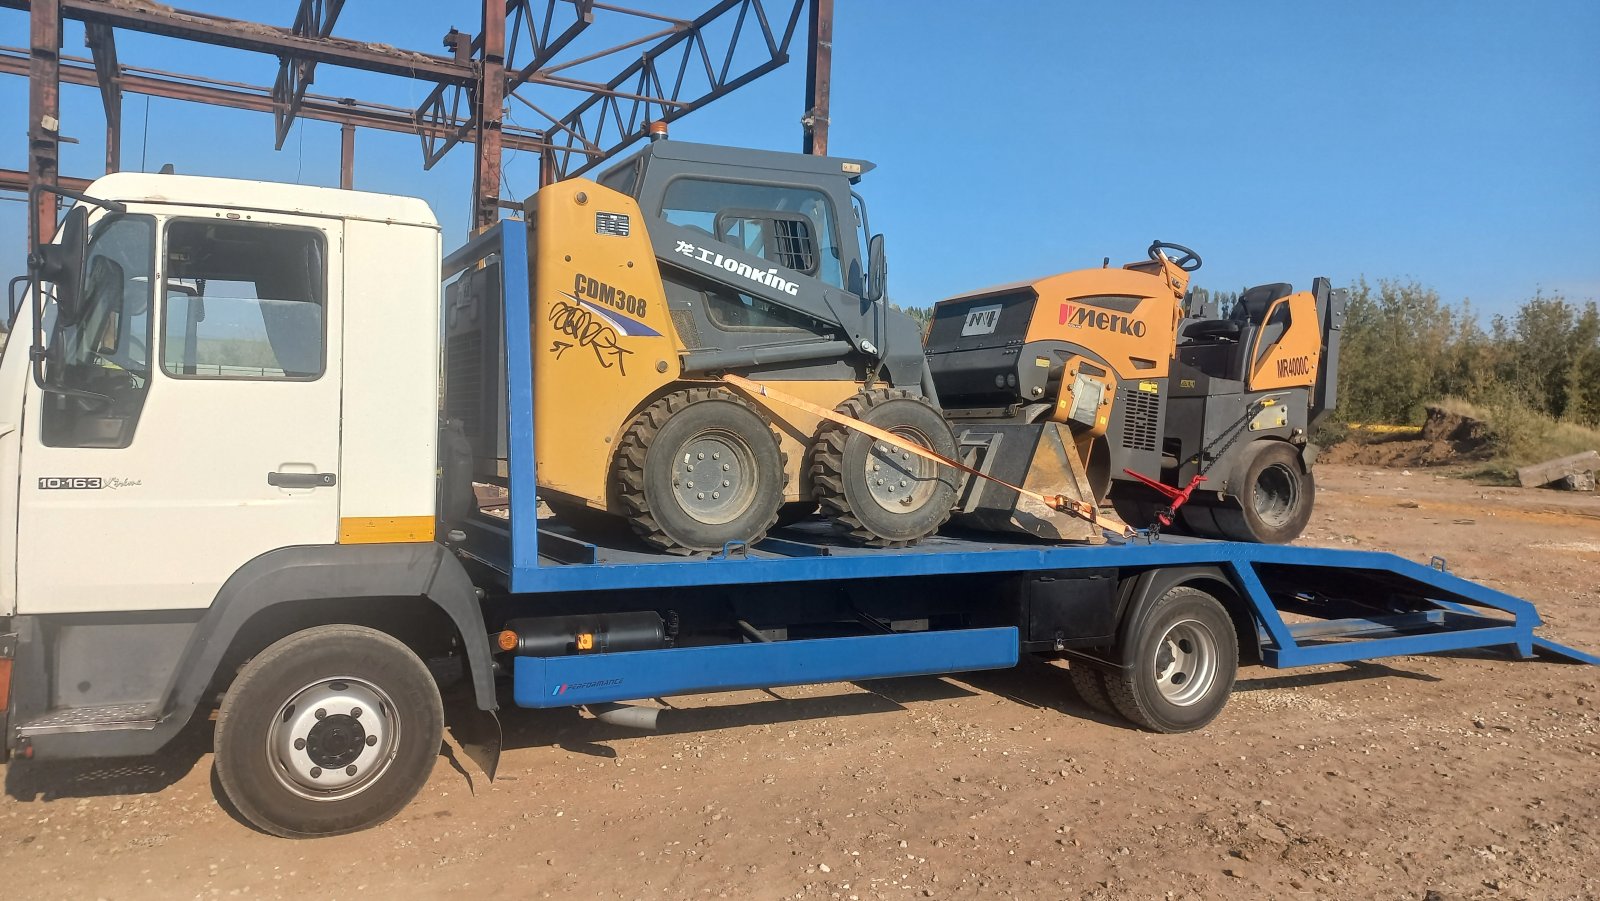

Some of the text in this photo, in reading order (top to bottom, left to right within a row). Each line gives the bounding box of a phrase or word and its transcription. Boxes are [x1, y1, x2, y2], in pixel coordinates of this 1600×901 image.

[674, 240, 714, 265] 龙工
[574, 273, 647, 318] CDM308
[1276, 355, 1310, 379] MR4000C
